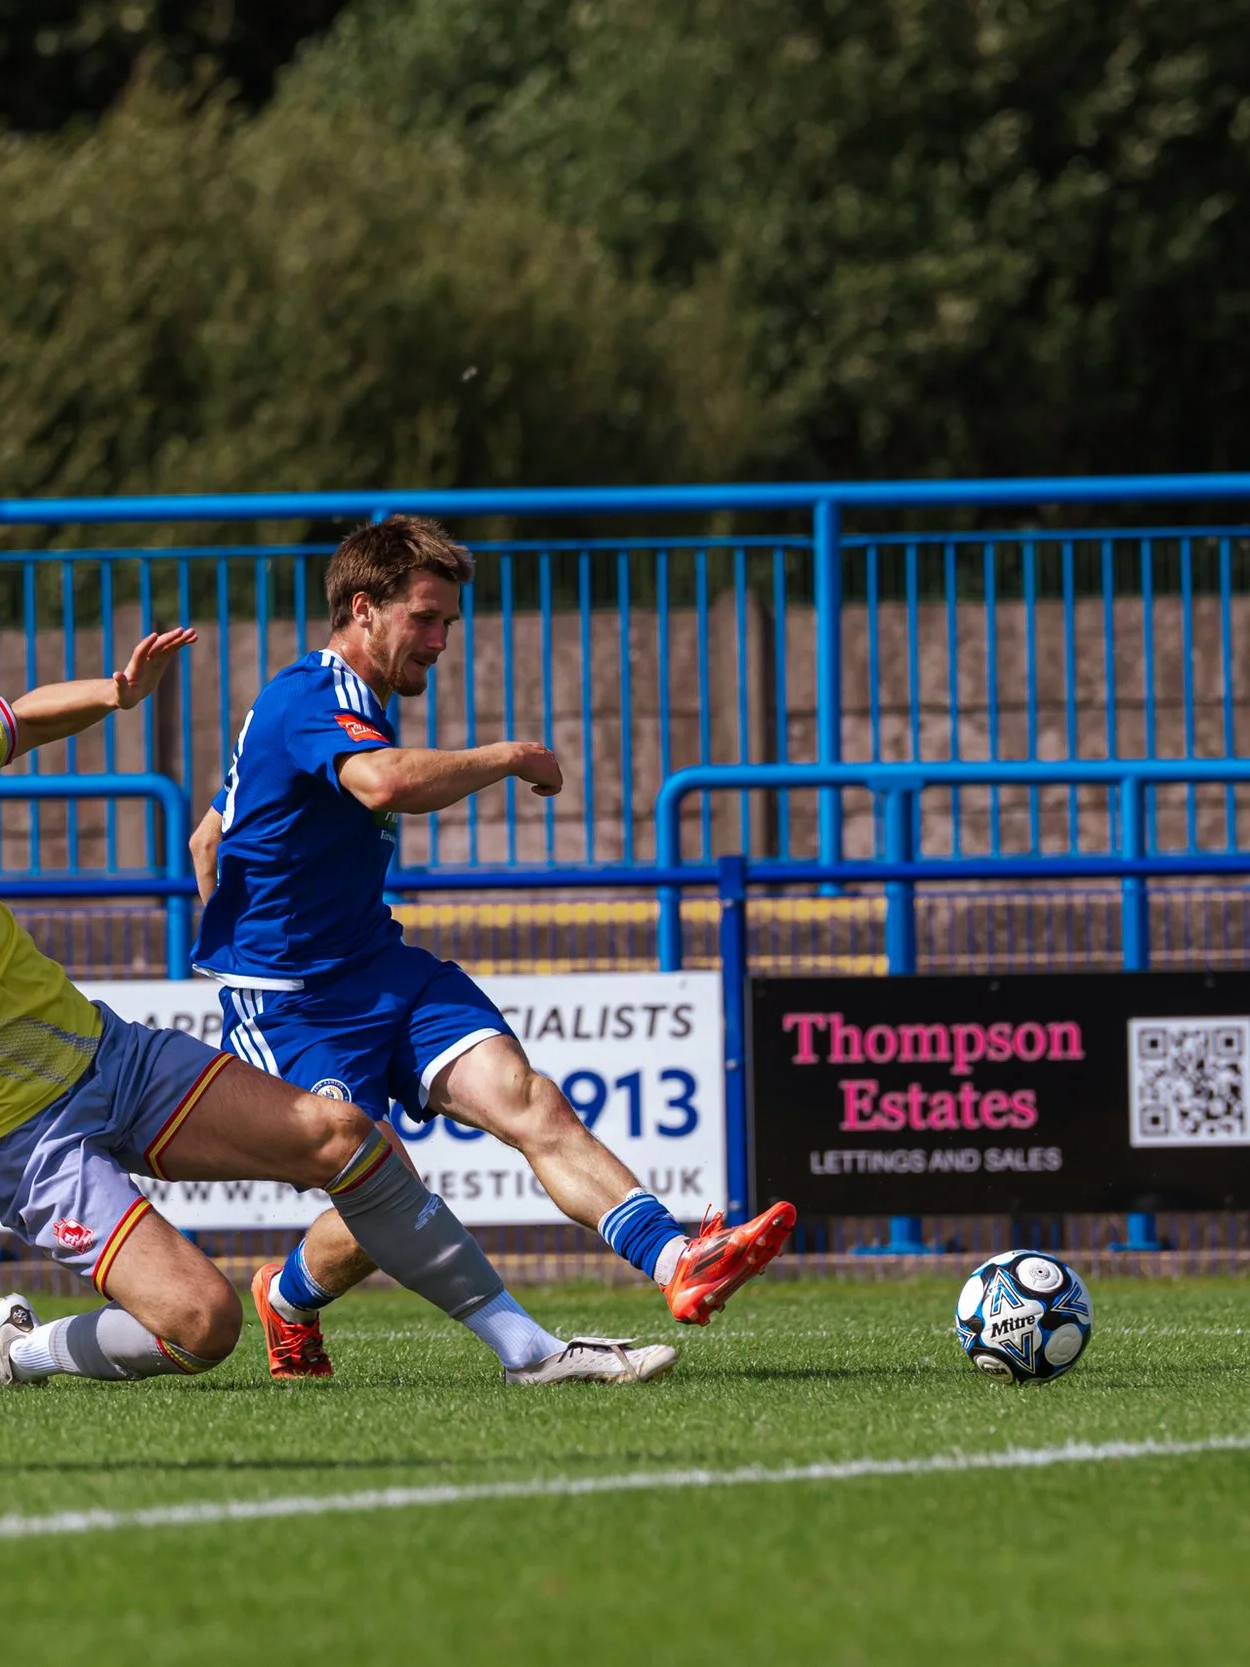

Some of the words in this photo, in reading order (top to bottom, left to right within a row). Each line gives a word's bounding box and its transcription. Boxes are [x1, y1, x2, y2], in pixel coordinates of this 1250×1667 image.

[501, 1003, 695, 1042] IALISTS
[782, 1013, 1084, 1075] Thompson
[535, 1067, 700, 1138] 913
[840, 1079, 1038, 1132] Estates
[810, 1148, 927, 1174] LETTINGS
[928, 1148, 981, 1173] AND
[984, 1147, 1062, 1172] SALES
[989, 1314, 1036, 1339] Mitre
